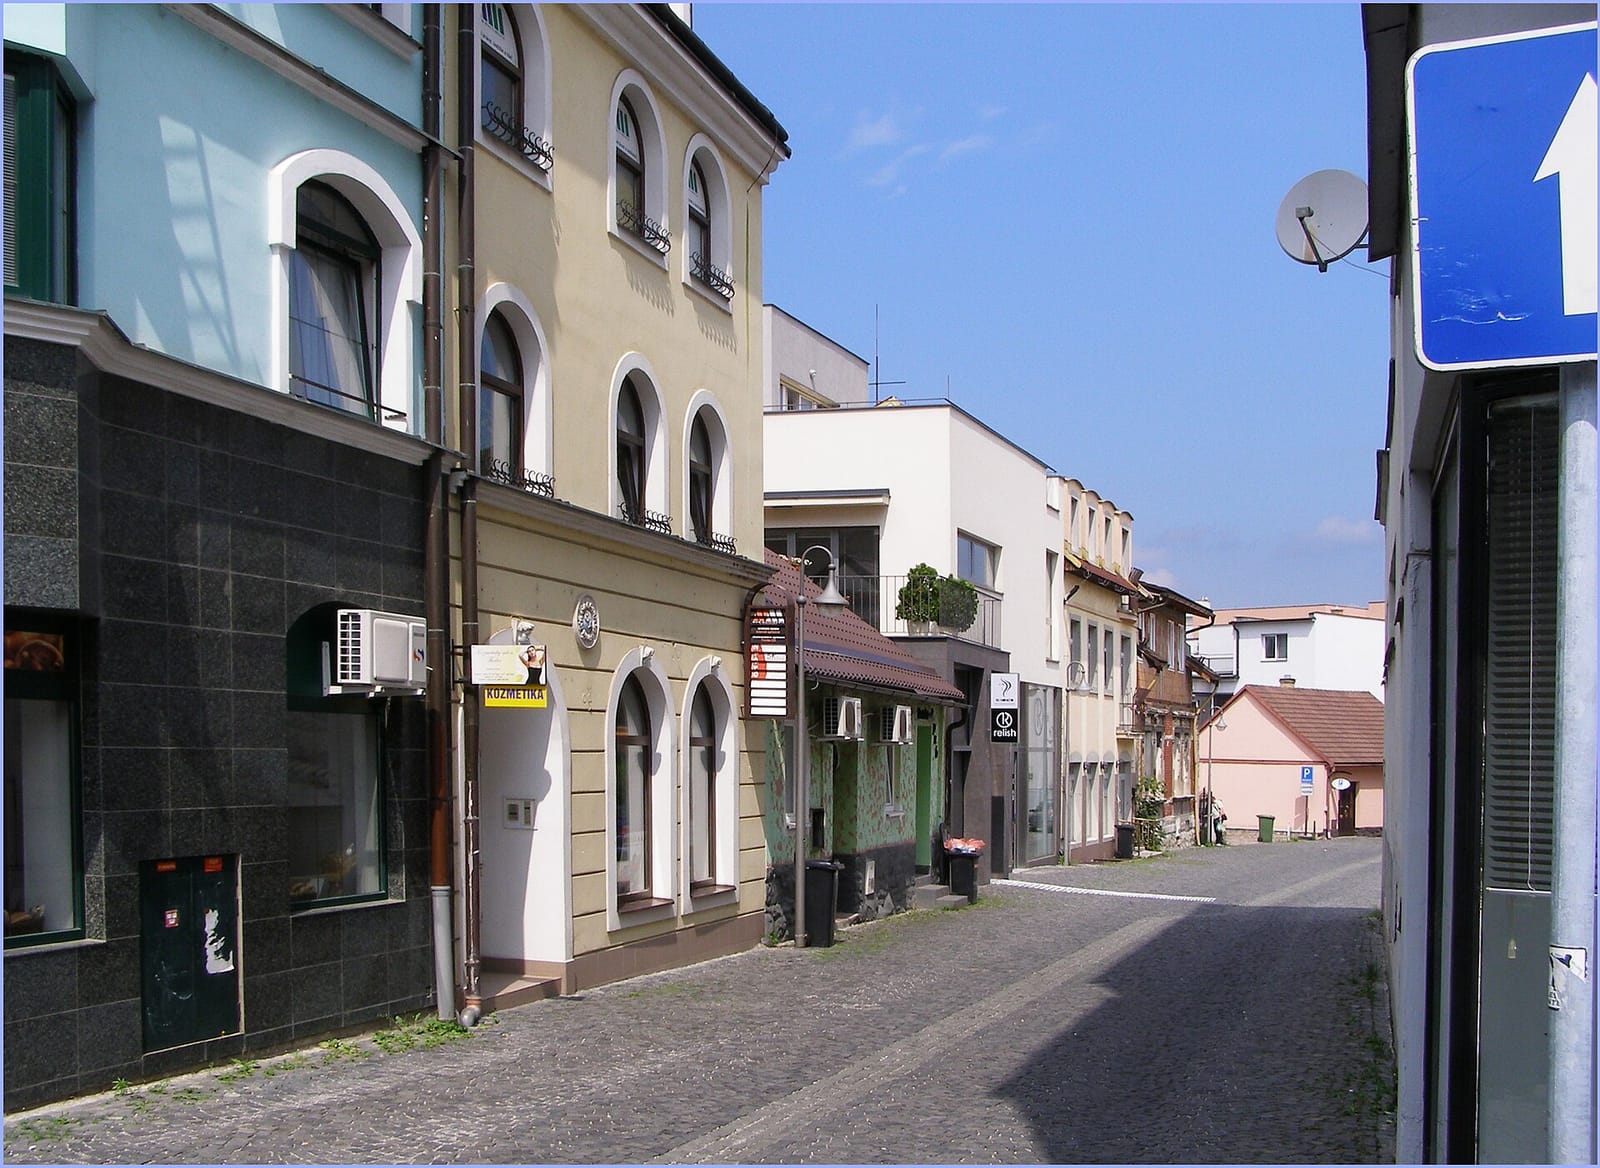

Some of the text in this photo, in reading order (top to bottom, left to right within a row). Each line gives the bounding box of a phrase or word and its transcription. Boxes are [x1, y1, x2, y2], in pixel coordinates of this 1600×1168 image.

[487, 688, 543, 699] KOZMETIKA
[993, 729, 1016, 737] relish
[1304, 768, 1310, 778] P
